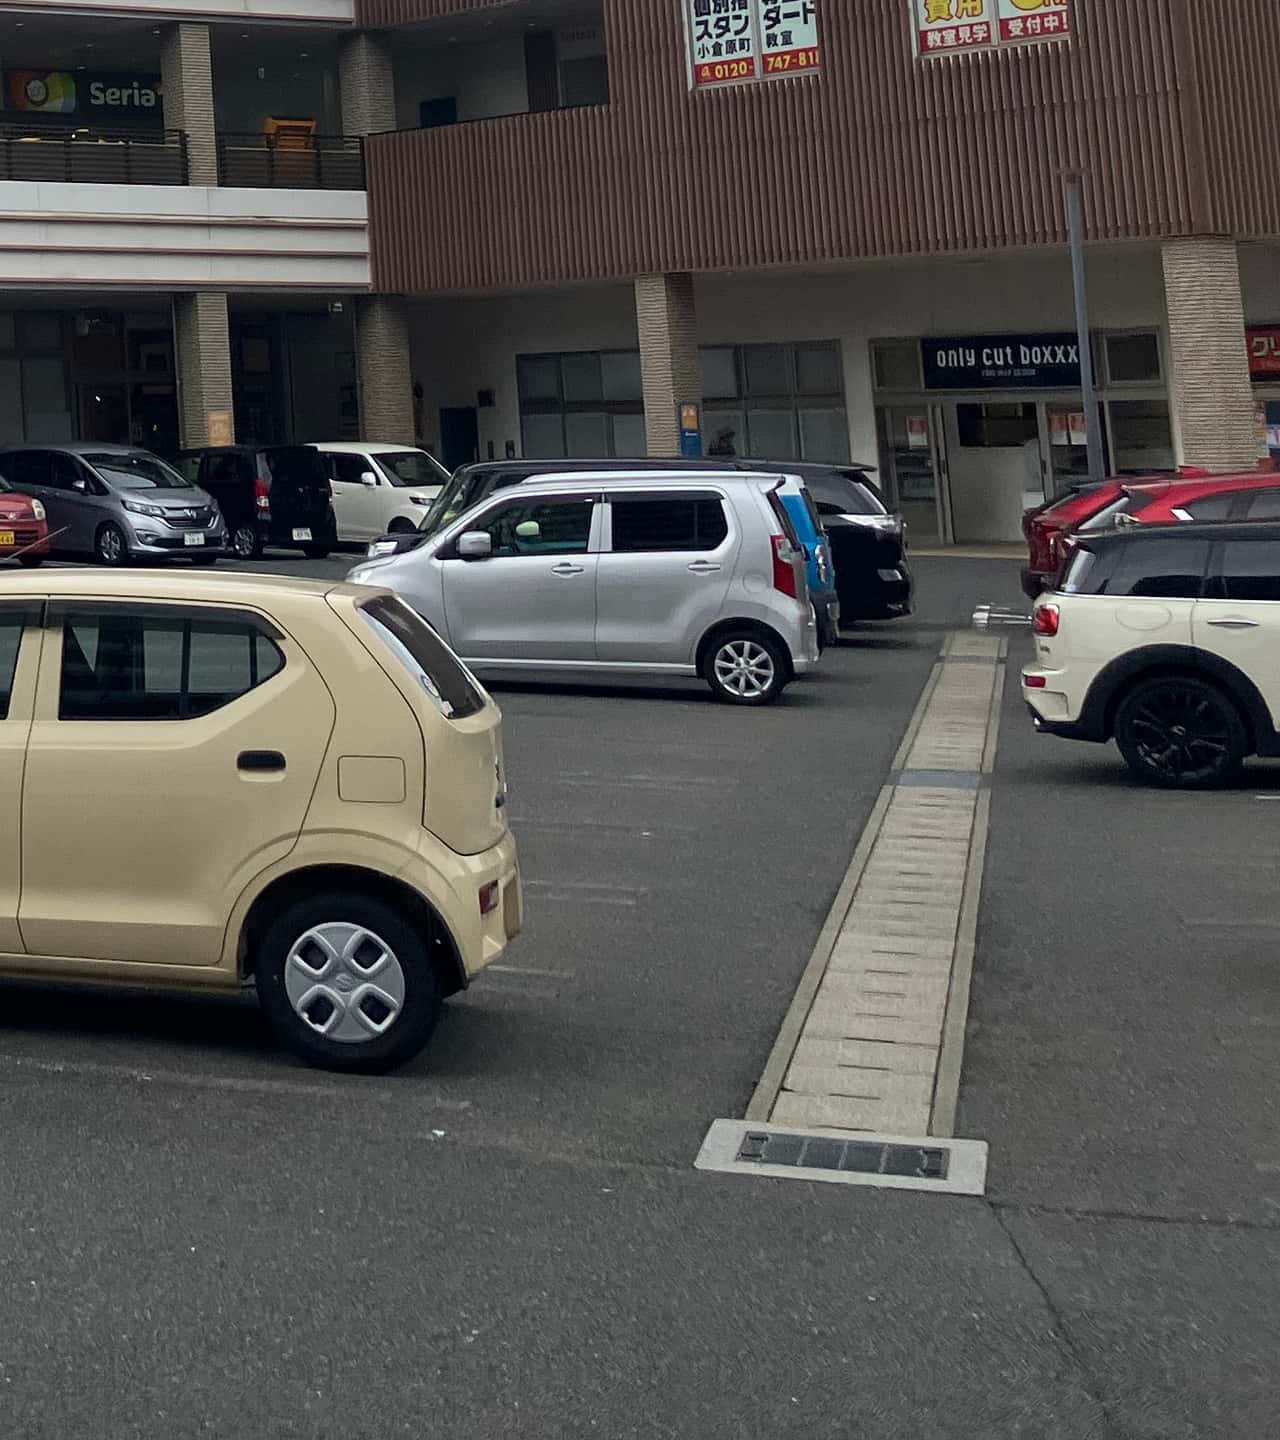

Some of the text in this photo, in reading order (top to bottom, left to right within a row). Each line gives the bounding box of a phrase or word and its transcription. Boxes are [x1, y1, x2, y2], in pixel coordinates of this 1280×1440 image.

[90, 81, 156, 107] Seria
[937, 347, 976, 367] only
[982, 345, 1013, 366] cut
